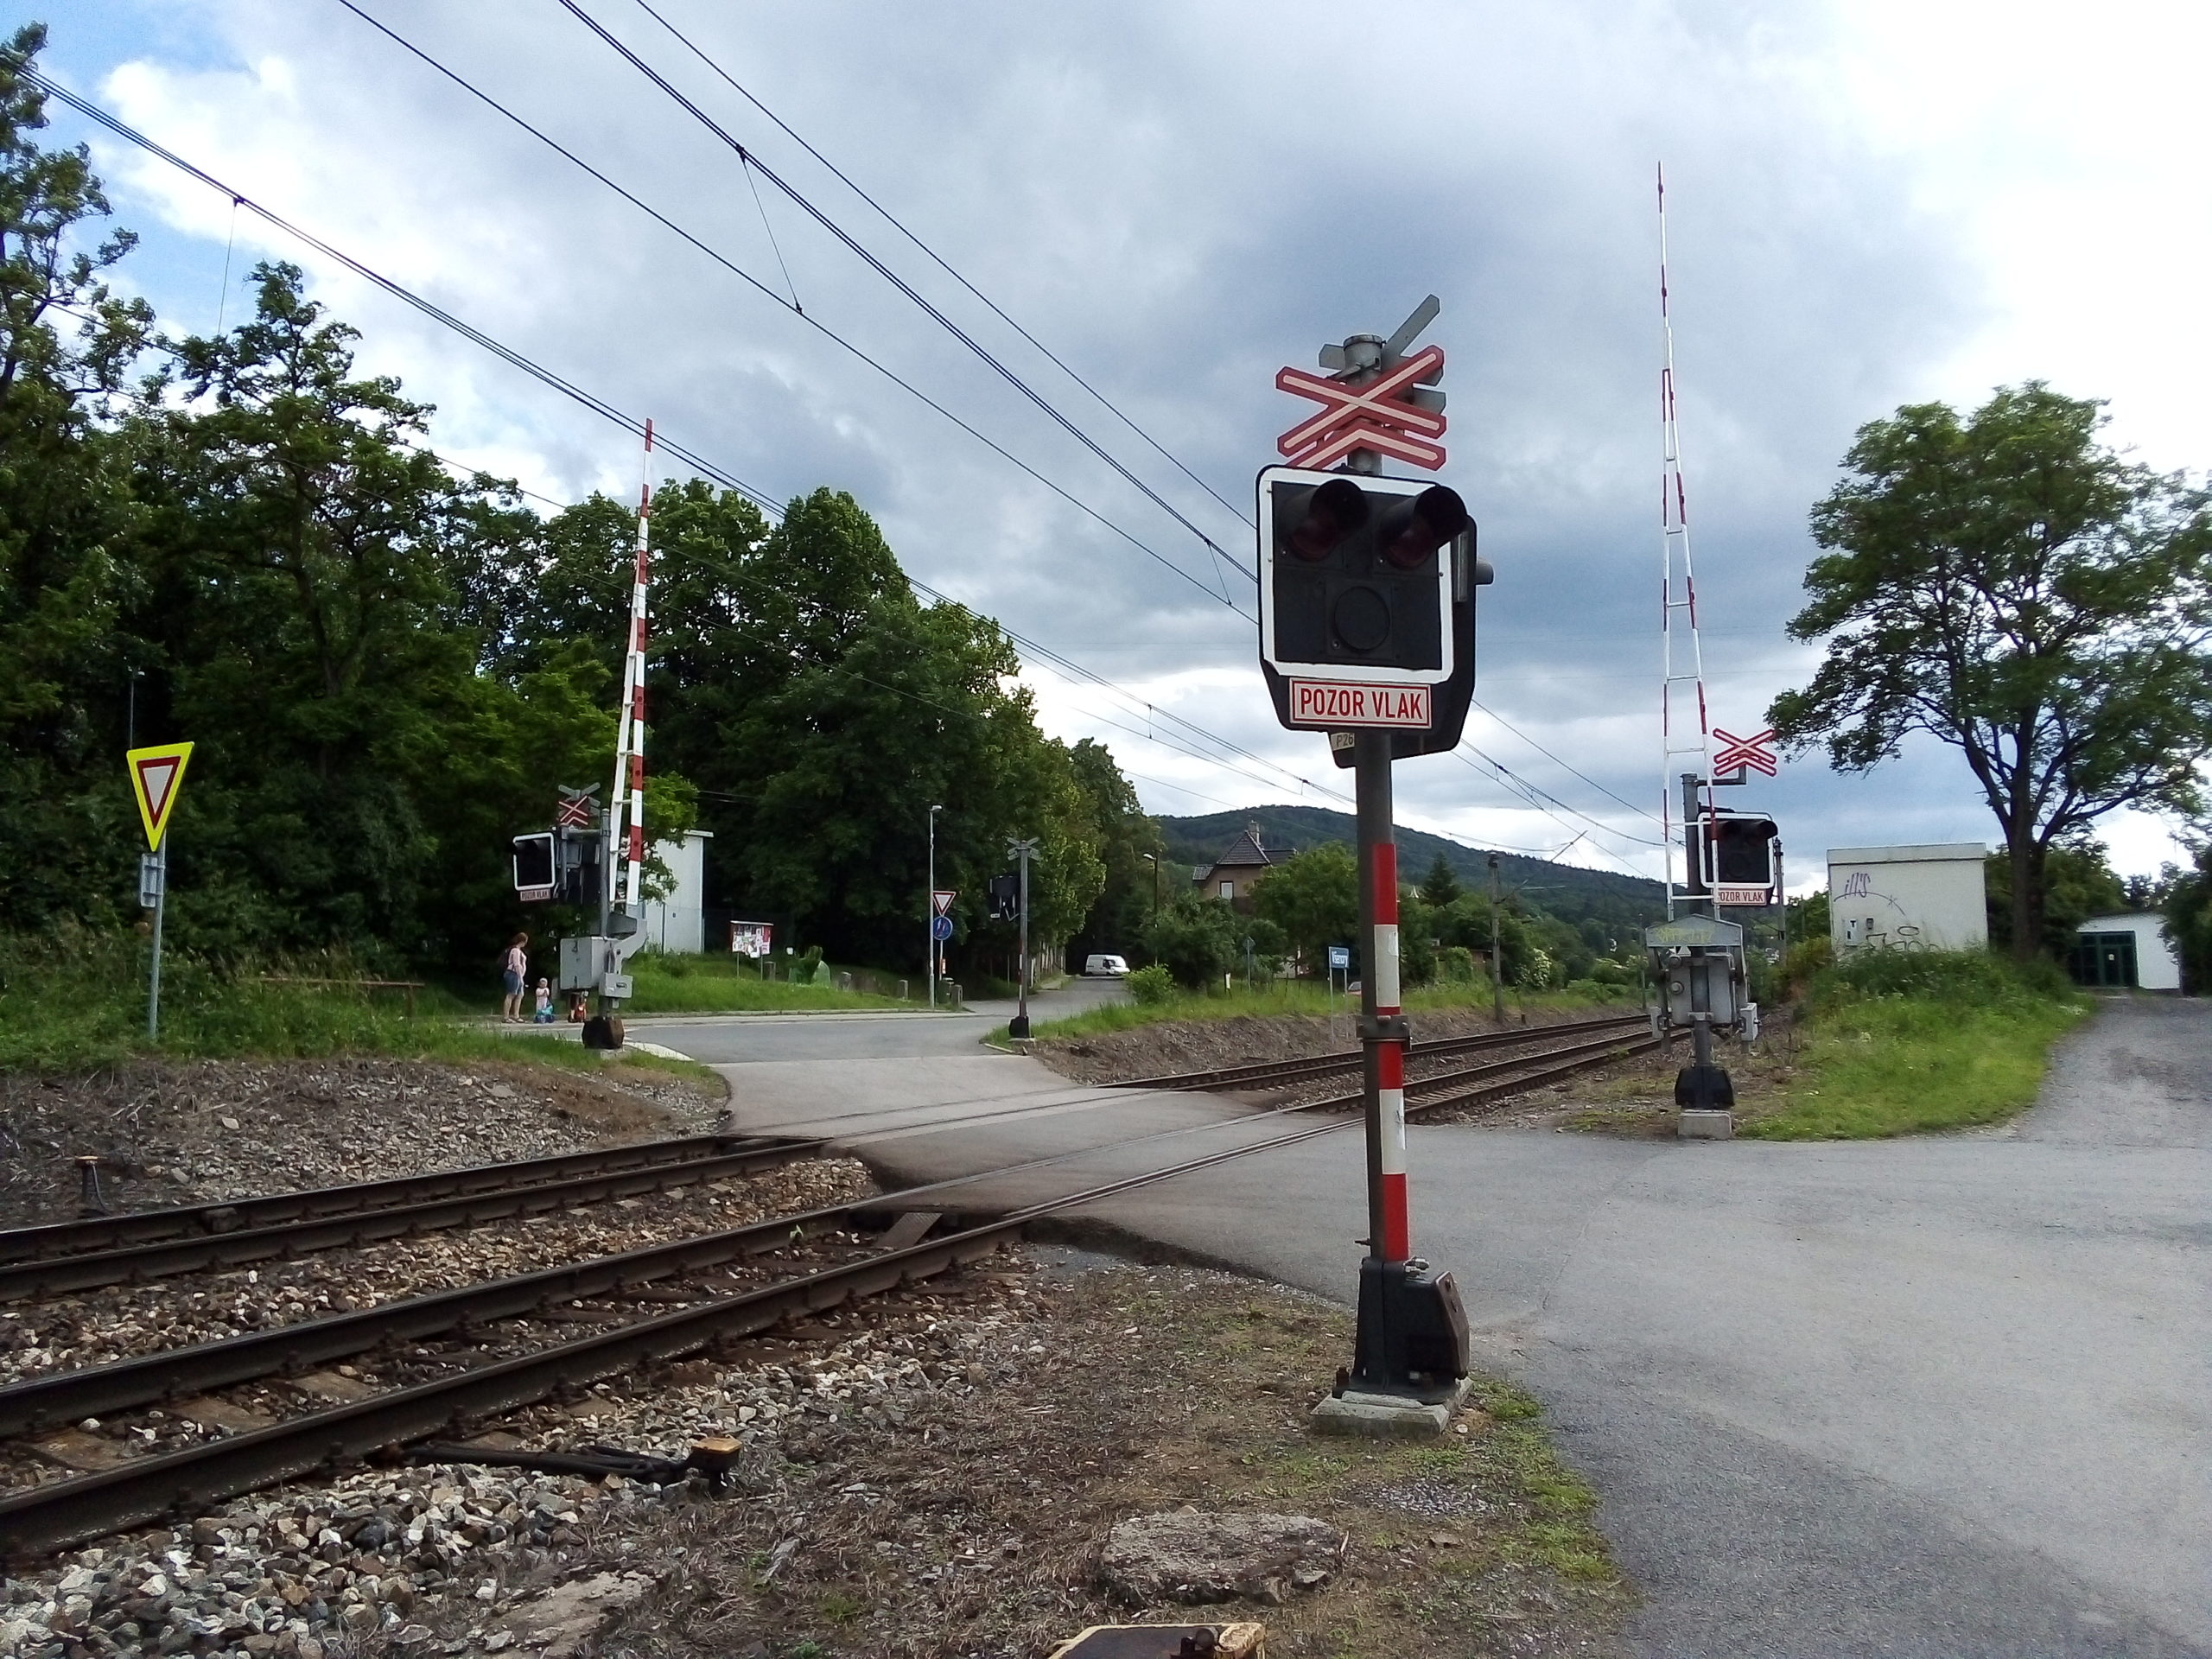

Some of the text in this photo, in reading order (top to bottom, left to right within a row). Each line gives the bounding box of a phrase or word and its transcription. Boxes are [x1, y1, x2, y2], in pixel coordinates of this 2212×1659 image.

[1300, 688, 1423, 719] POZOR VLAK
[1719, 891, 1764, 902] OZOR VLAK
